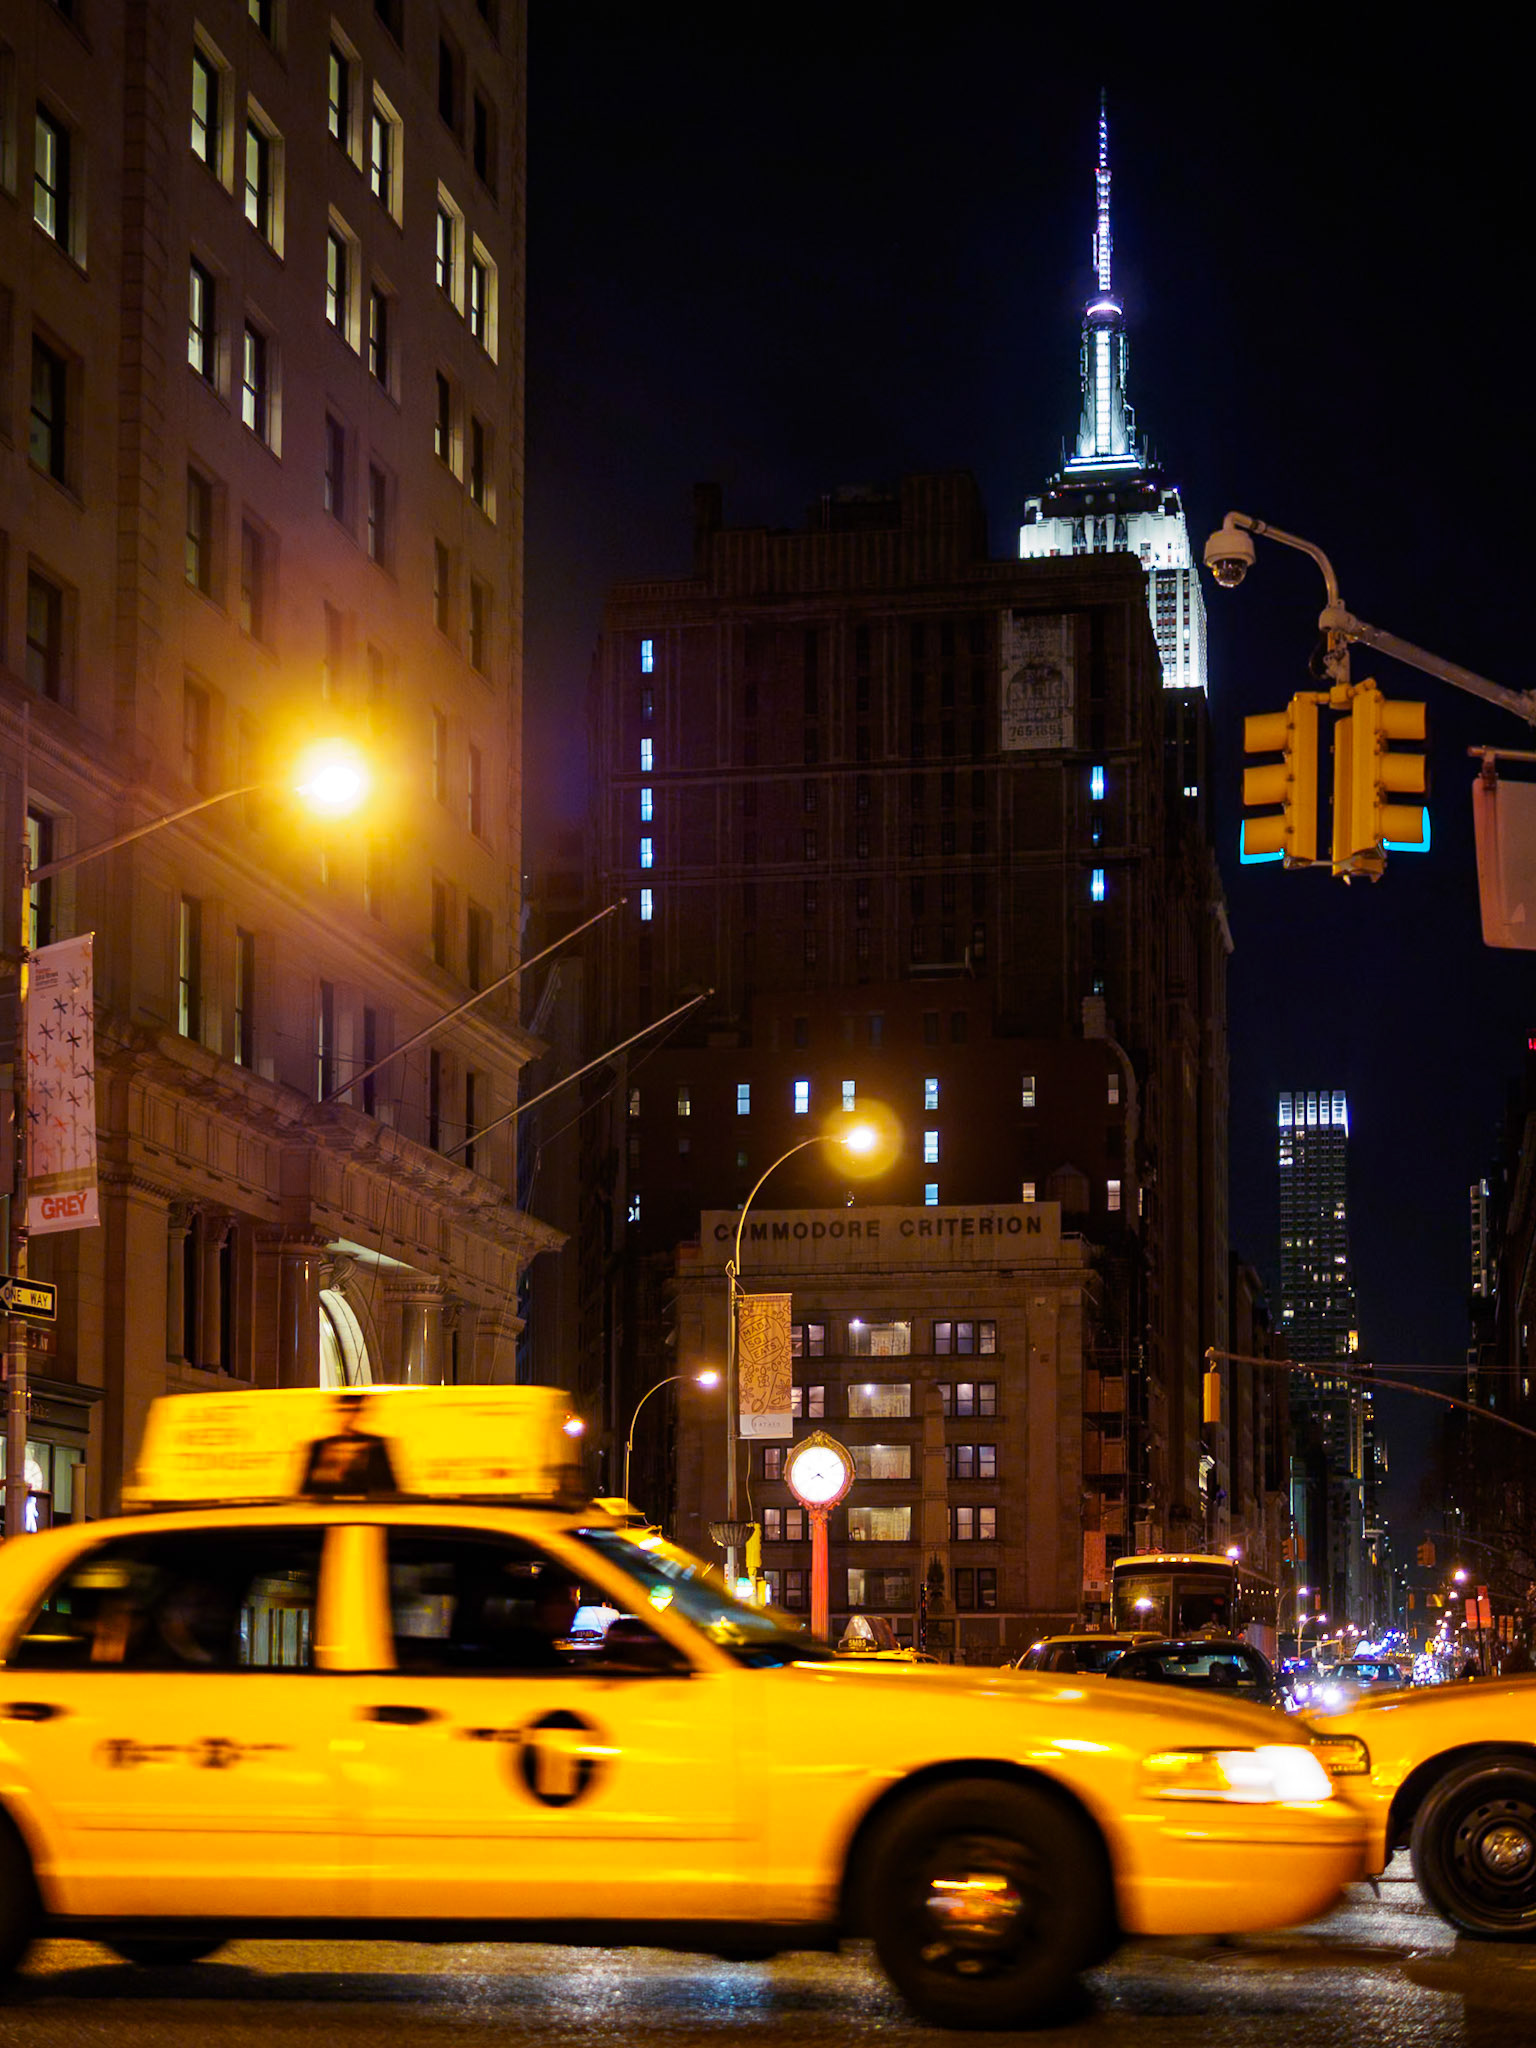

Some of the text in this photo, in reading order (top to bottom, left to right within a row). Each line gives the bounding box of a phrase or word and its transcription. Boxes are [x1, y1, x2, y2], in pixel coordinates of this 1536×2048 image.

[41, 1191, 88, 1219] GREY
[713, 1215, 1044, 1242] COMMODORE CRITERION
[4, 1286, 48, 1307] ONE WAY
[742, 1321, 767, 1338] MAD.
[753, 1341, 779, 1359] EATS.
